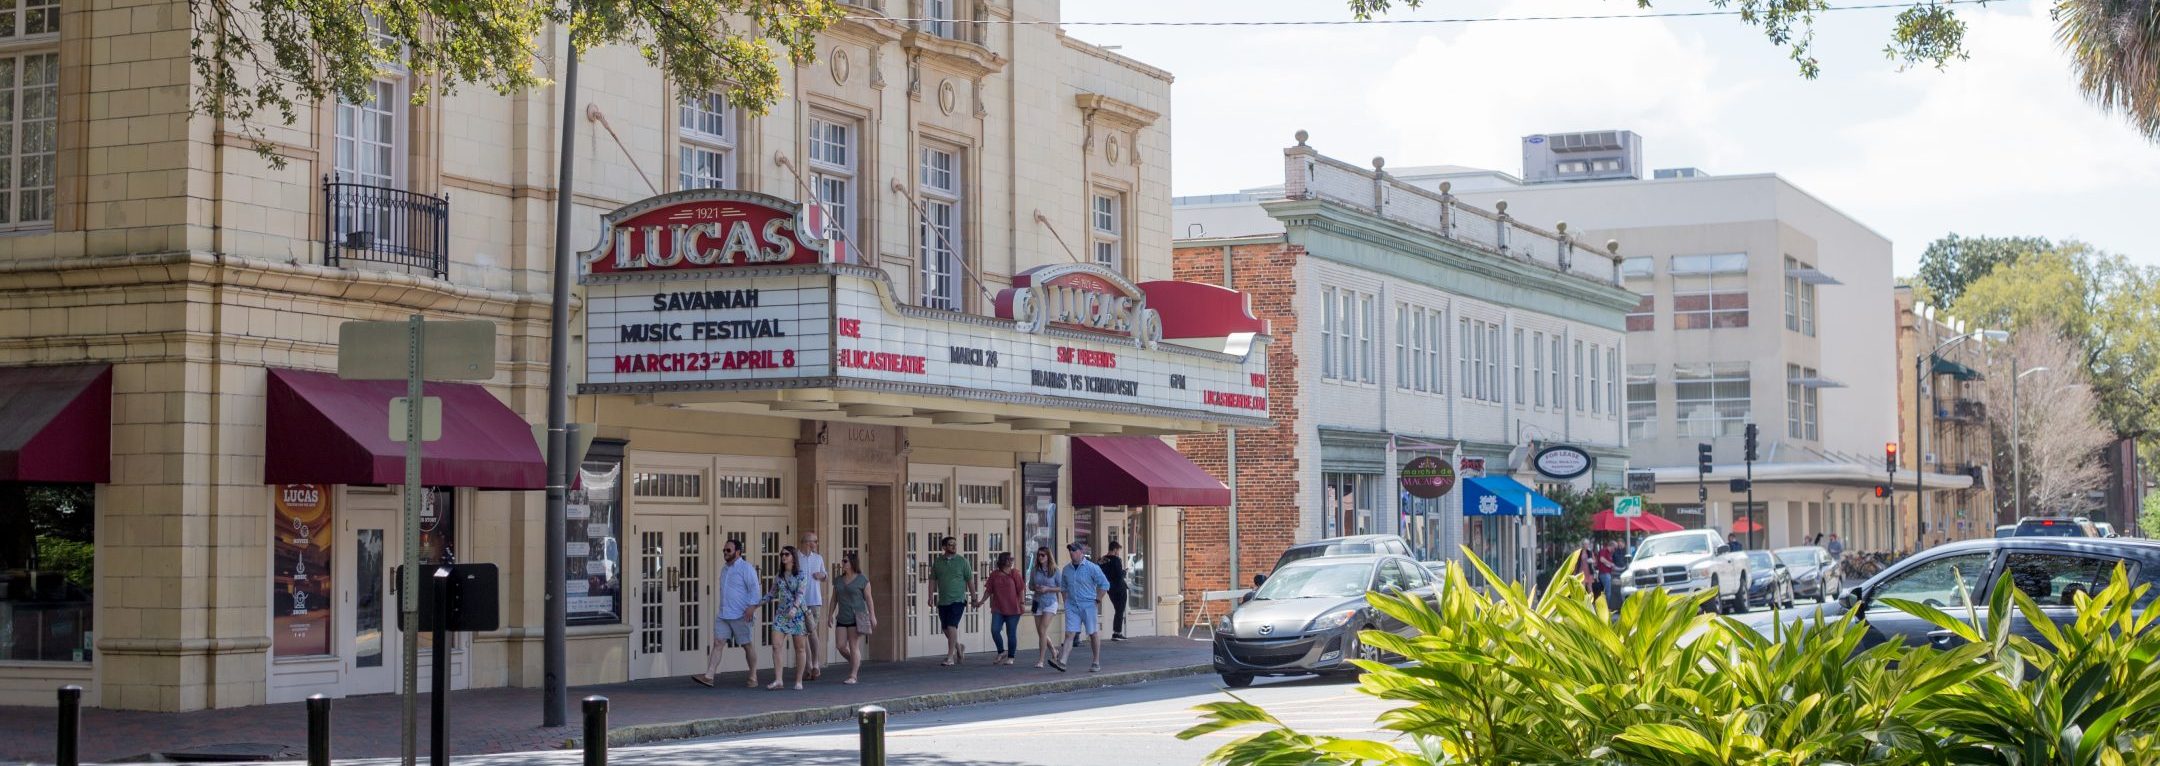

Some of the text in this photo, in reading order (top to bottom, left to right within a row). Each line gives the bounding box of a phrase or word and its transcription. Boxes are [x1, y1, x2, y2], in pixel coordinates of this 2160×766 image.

[696, 207, 720, 219] 1921
[612, 217, 796, 269] LUCAS
[653, 288, 759, 311] SAVANNAH
[620, 318, 786, 343] MUSIC FESTIVAL
[839, 318, 861, 339] USE
[615, 353, 684, 373] MARCH
[722, 350, 779, 369] APRIL
[782, 349, 795, 367] 8
[838, 349, 926, 375] #LUCASTHEATRE
[950, 345, 998, 368] MARCH 24
[1077, 348, 1117, 369] PRESENTS
[1070, 373, 1083, 391] VS
[848, 427, 875, 442] LUCAS
[1559, 451, 1580, 460] LEASE
[283, 489, 319, 503] LUCAS
